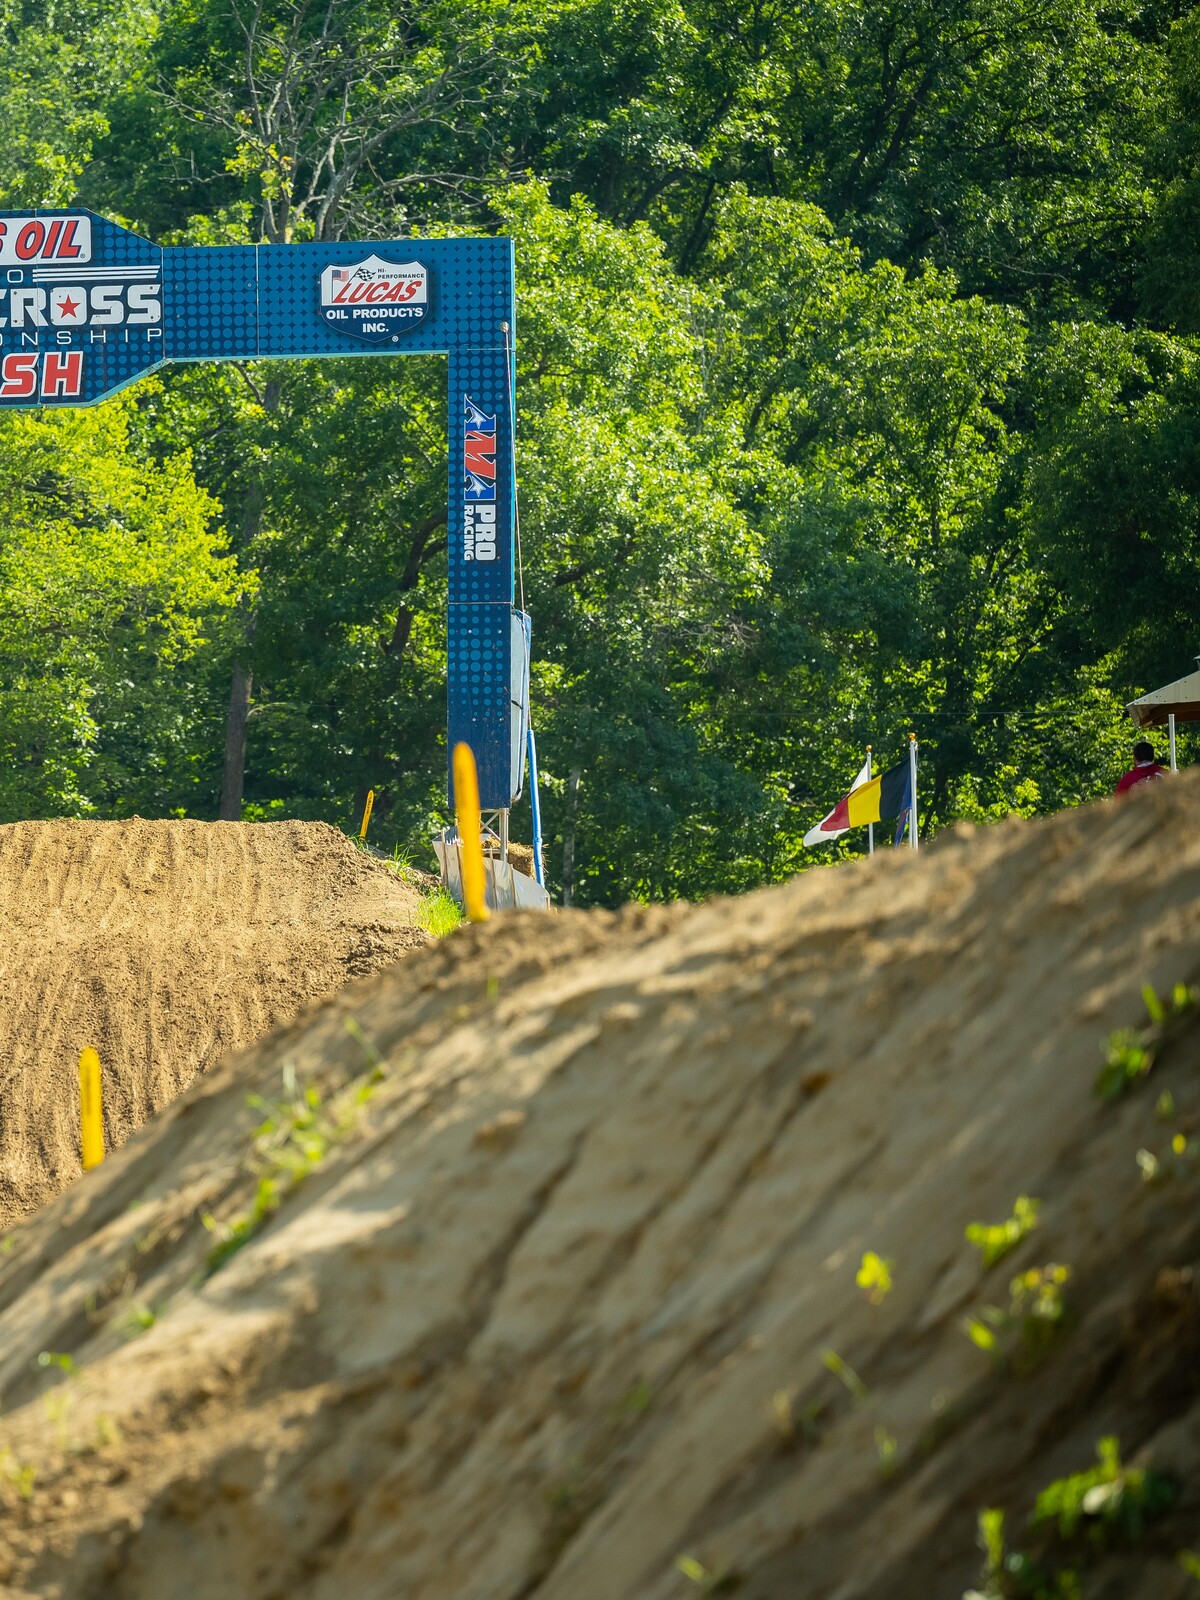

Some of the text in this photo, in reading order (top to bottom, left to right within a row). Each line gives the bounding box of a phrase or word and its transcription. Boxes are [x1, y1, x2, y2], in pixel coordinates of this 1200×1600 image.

[15, 219, 83, 260] OIL
[332, 280, 422, 303] LUCAS
[325, 307, 424, 320] OIL PRODUCTS
[362, 322, 390, 333] INC.
[463, 504, 475, 561] RACING
[475, 504, 496, 561] PRO
